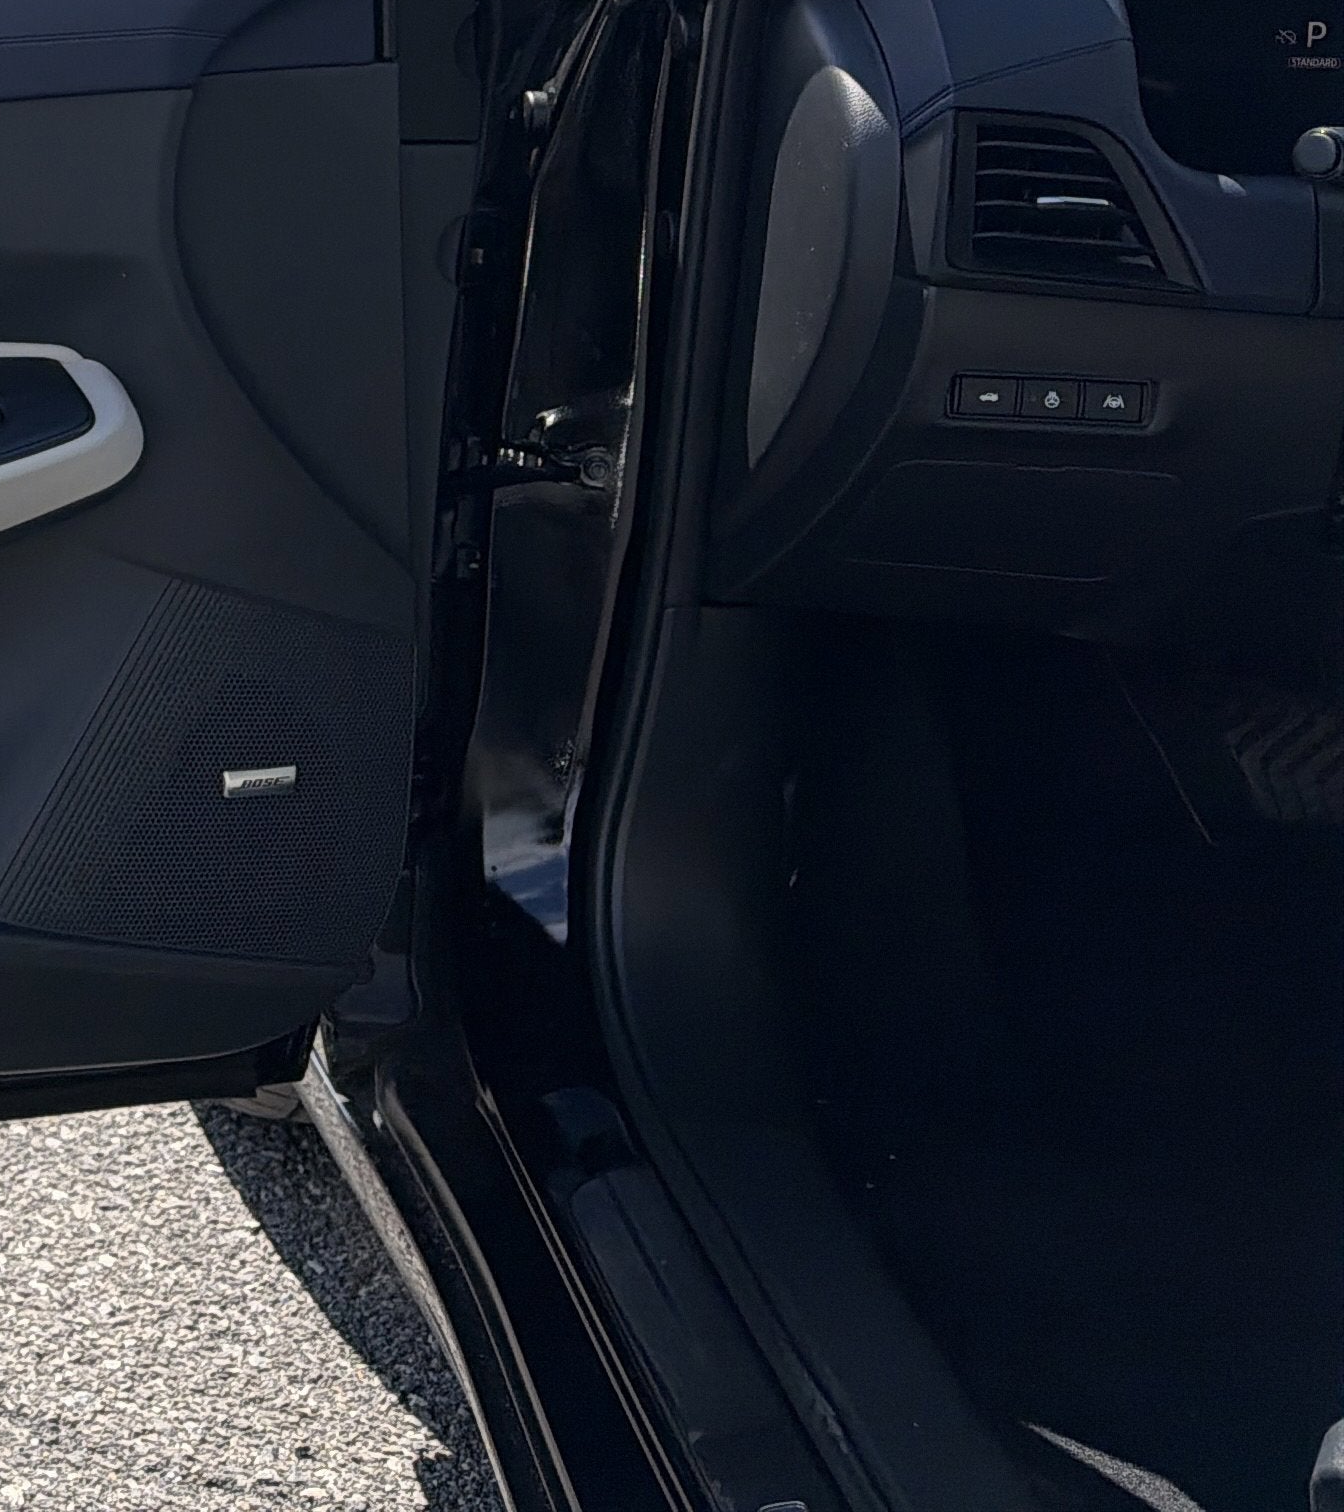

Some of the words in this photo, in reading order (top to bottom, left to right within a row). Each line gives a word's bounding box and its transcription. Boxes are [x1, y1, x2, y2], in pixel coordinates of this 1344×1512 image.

[1306, 21, 1327, 48] P
[1291, 57, 1337, 68] STANDARD
[237, 775, 291, 790] BOSE
